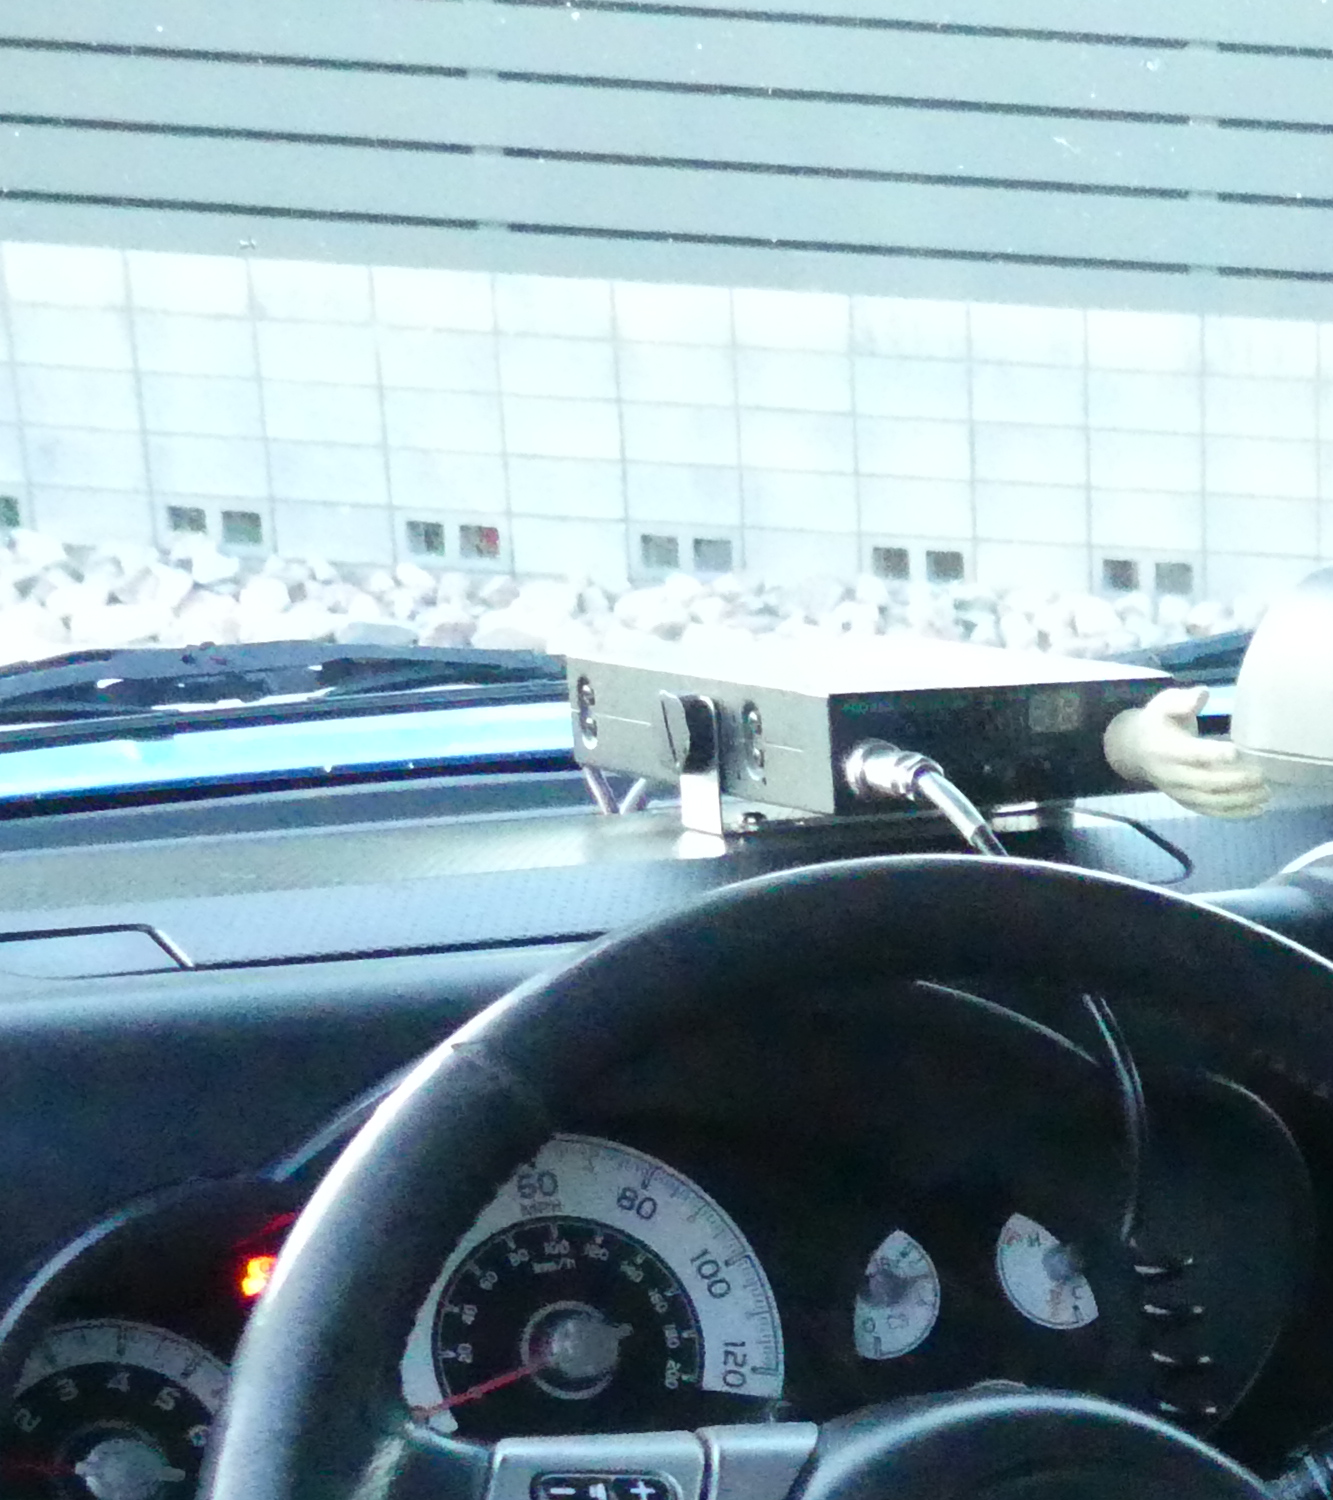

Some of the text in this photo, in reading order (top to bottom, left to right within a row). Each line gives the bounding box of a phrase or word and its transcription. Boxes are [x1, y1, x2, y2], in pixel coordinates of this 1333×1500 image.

[517, 1168, 558, 1199] 60
[616, 1187, 657, 1220] 80
[689, 1248, 731, 1299] 100
[723, 1341, 747, 1389] 120
[57, 1377, 78, 1401] 3
[107, 1372, 130, 1392] 4
[153, 1386, 180, 1411] 5
